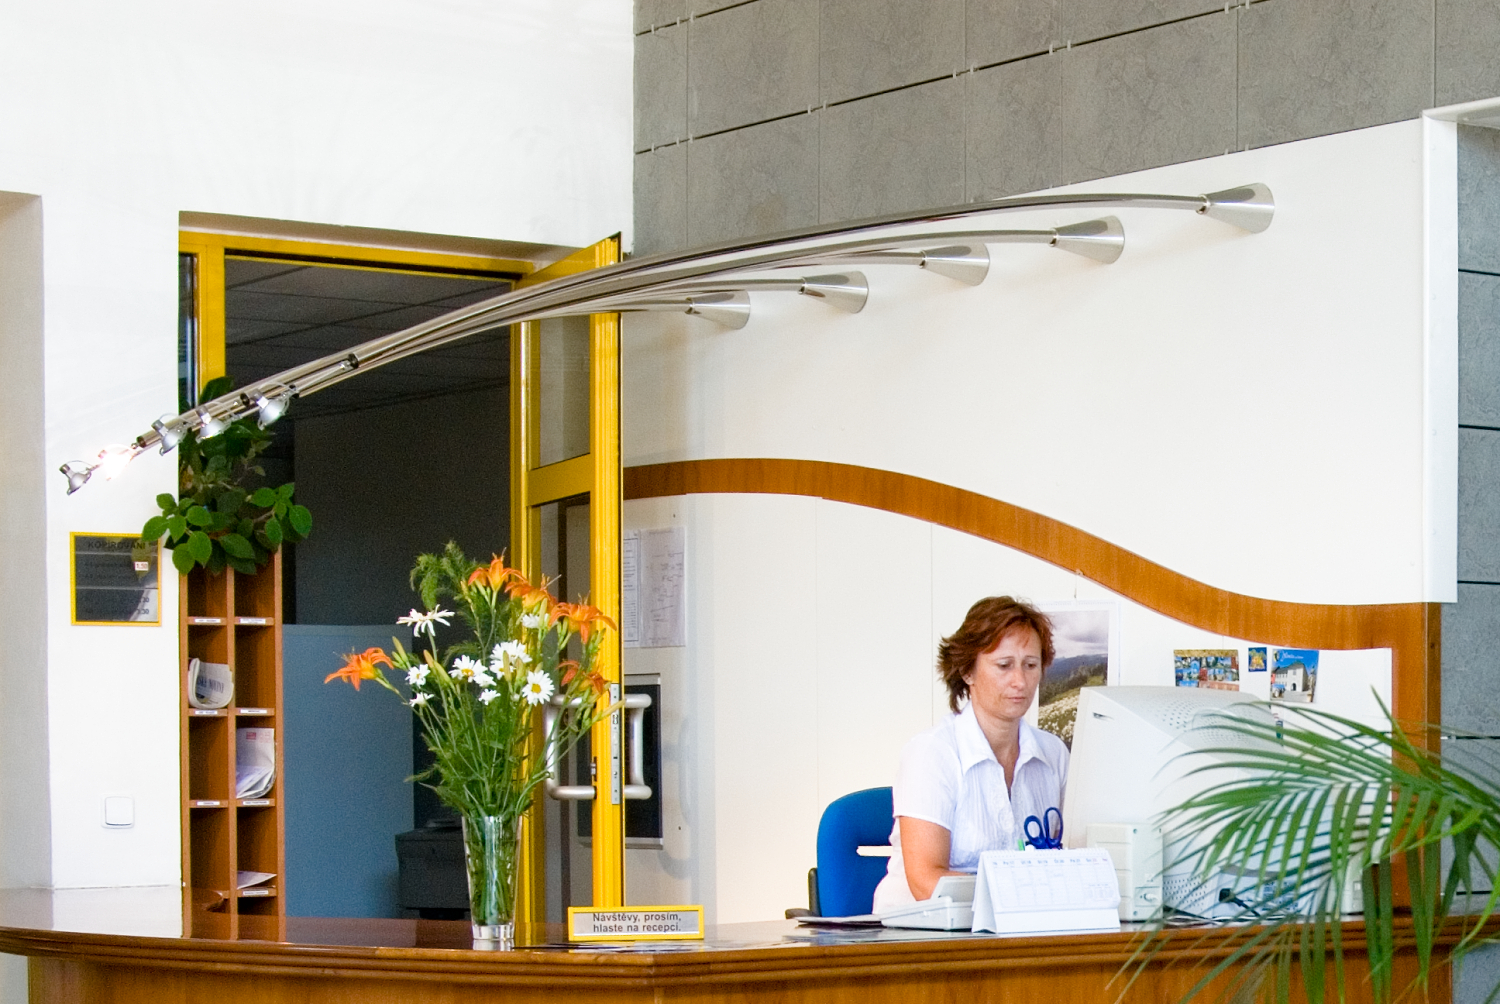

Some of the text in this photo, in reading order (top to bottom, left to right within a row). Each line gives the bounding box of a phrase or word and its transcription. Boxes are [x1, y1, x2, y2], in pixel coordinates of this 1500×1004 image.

[593, 912, 682, 923] Návštěvy, prosím,
[593, 922, 682, 933] hlaste na recepci.
